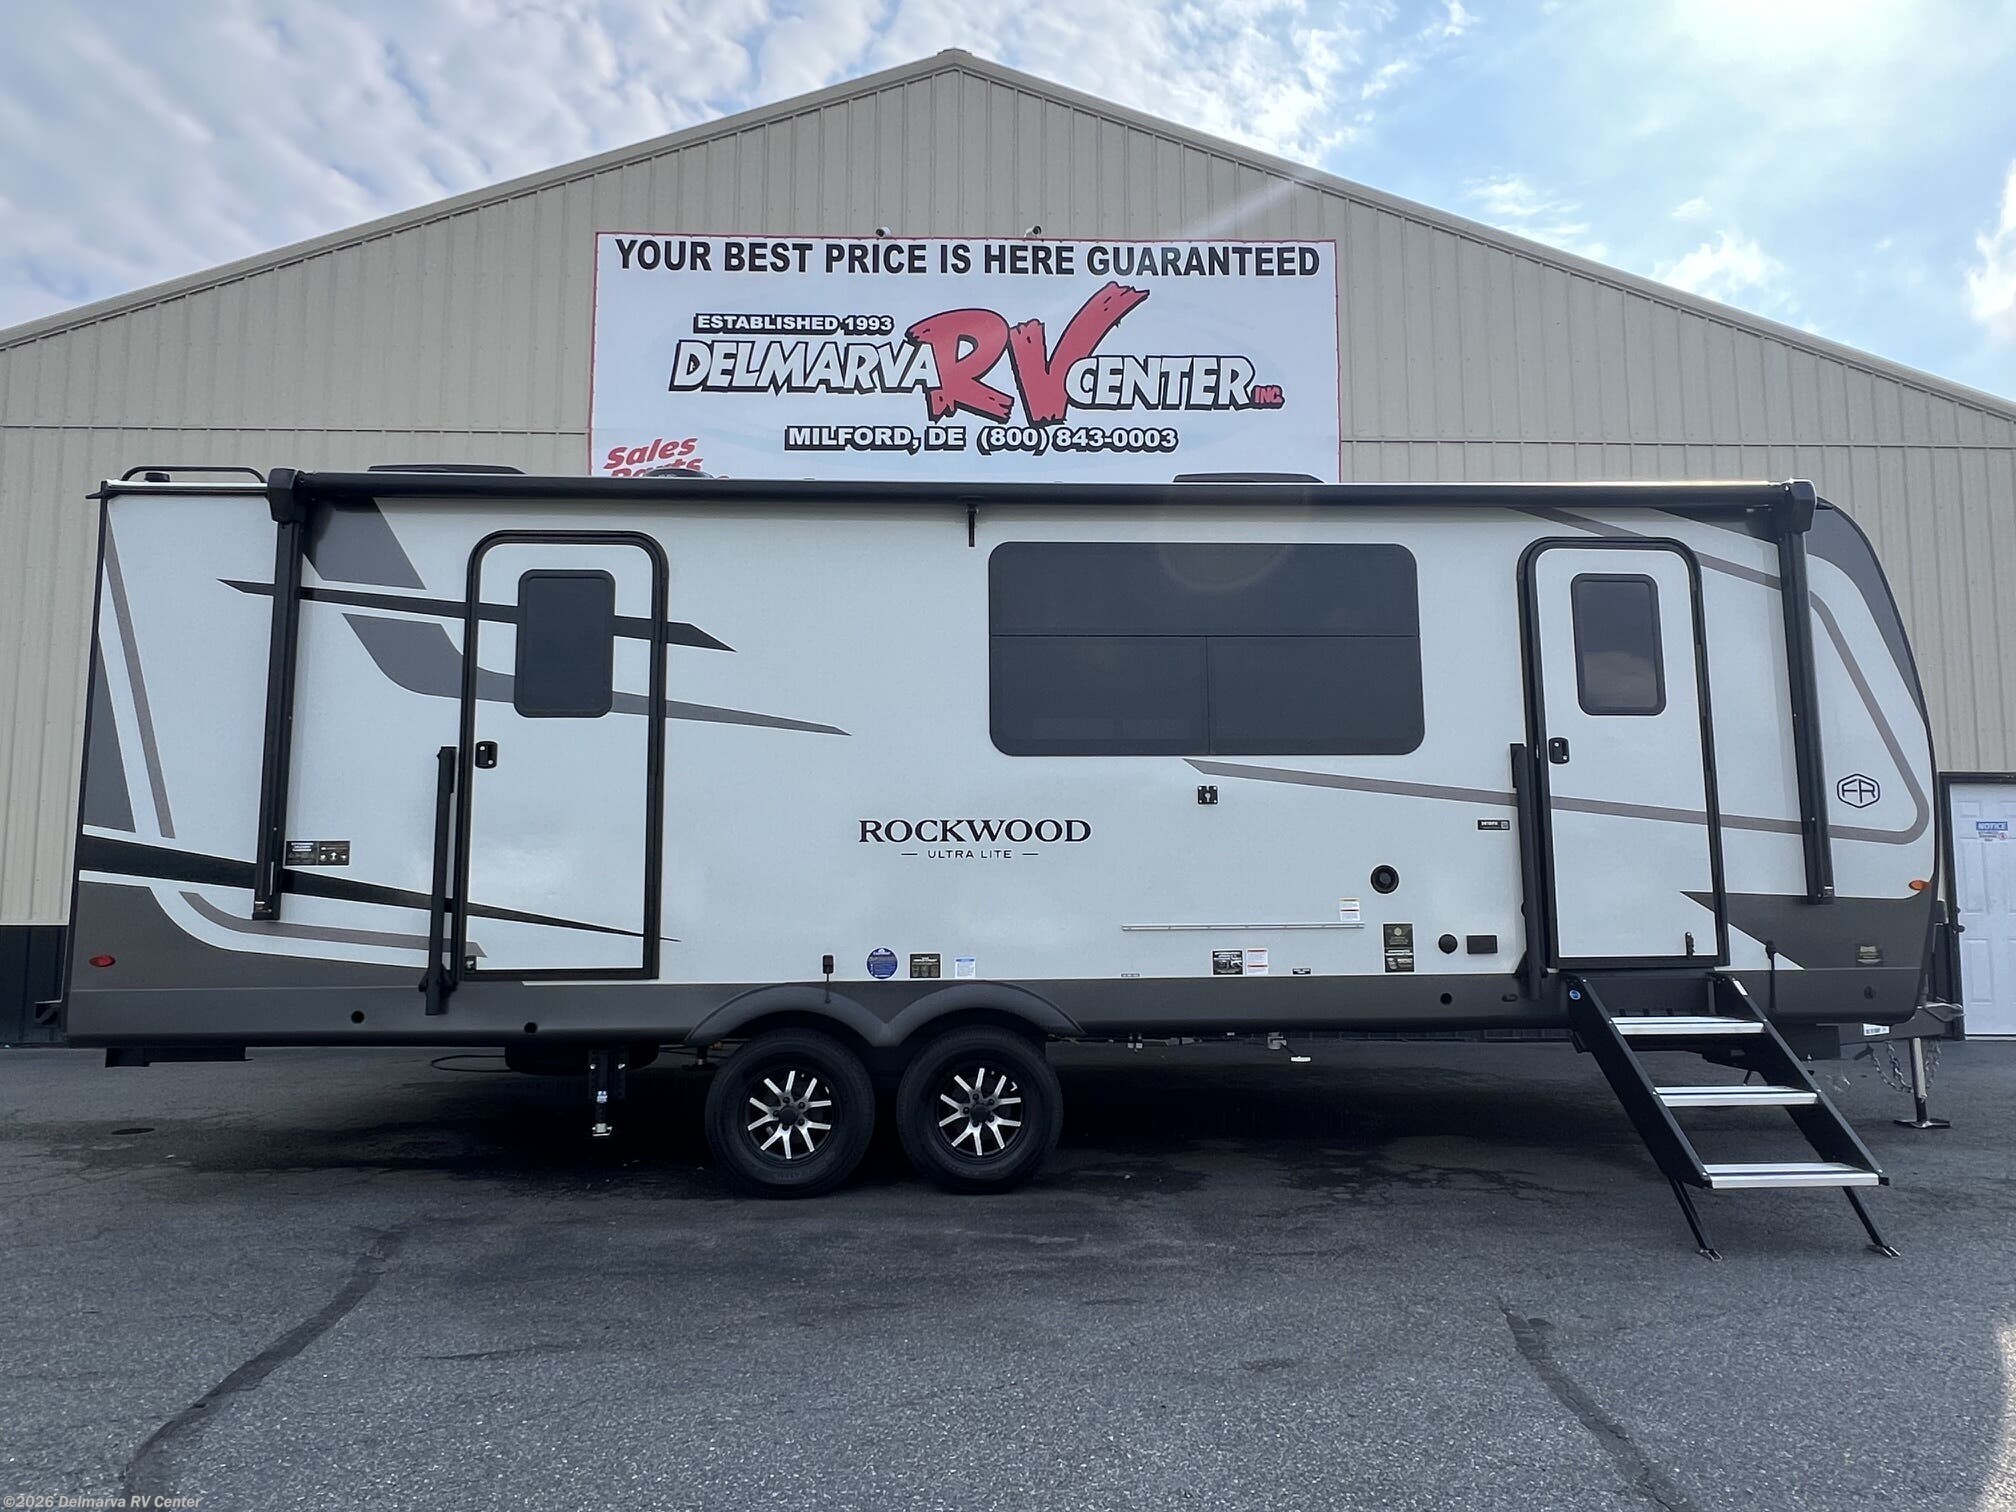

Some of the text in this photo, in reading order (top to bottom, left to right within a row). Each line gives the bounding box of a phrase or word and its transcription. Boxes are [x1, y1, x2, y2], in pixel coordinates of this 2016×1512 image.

[615, 239, 1320, 276] YOUR BEST PRICE IS HERE GUARANTEED
[694, 313, 894, 335] ESTABLISHED 1993
[669, 340, 942, 396] DELMARVA
[905, 281, 1150, 427] RV
[1065, 355, 1255, 410] CENTER
[603, 438, 698, 469] Sales
[785, 426, 1178, 455] MILFORD, DE (800) 843-0003
[859, 819, 1092, 843] ROCKWOOD
[1978, 822, 2006, 830] NOTICE
[927, 850, 1012, 859] ULTRA LITE
